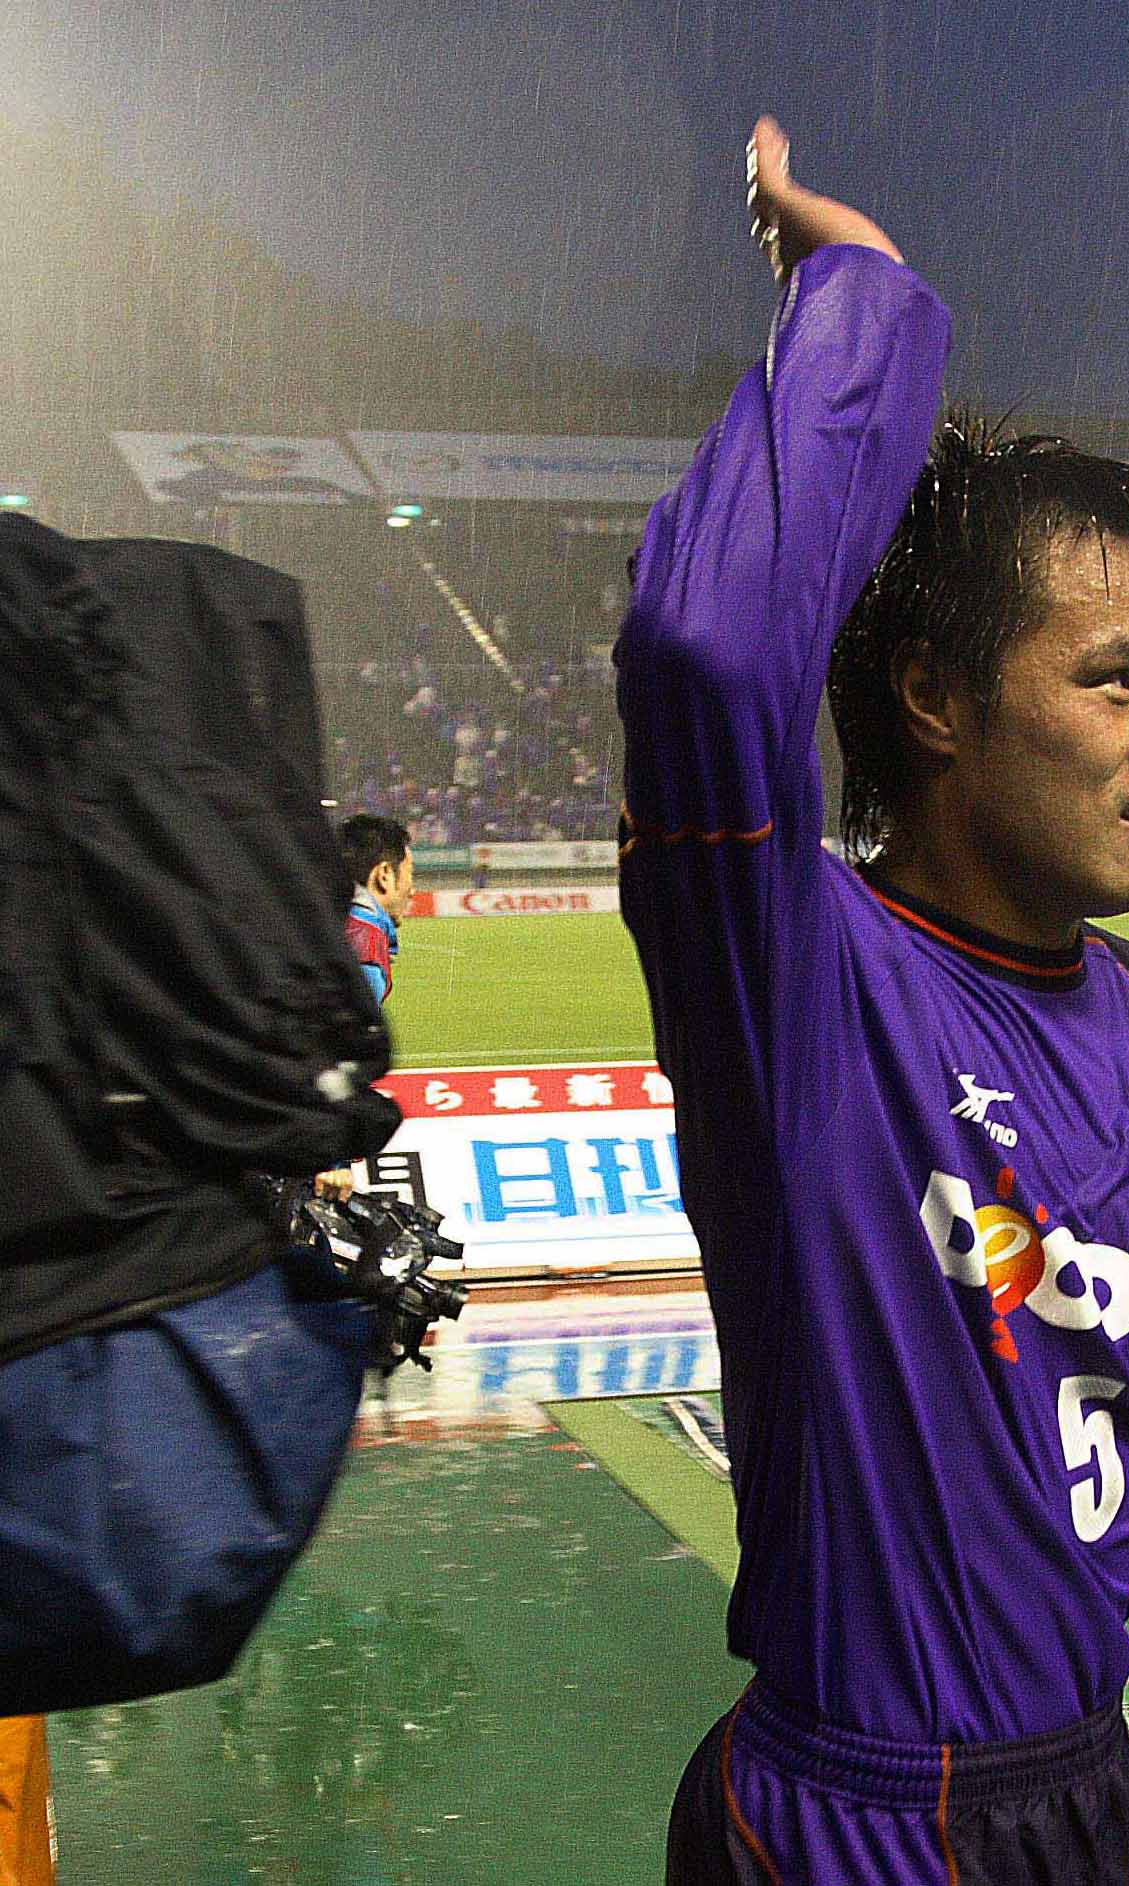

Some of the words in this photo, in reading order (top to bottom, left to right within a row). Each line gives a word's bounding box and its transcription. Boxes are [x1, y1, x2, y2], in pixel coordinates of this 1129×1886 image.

[461, 890, 591, 914] Canon
[371, 1072, 675, 1112] ら最新
[1058, 1375, 1127, 1543] 5
